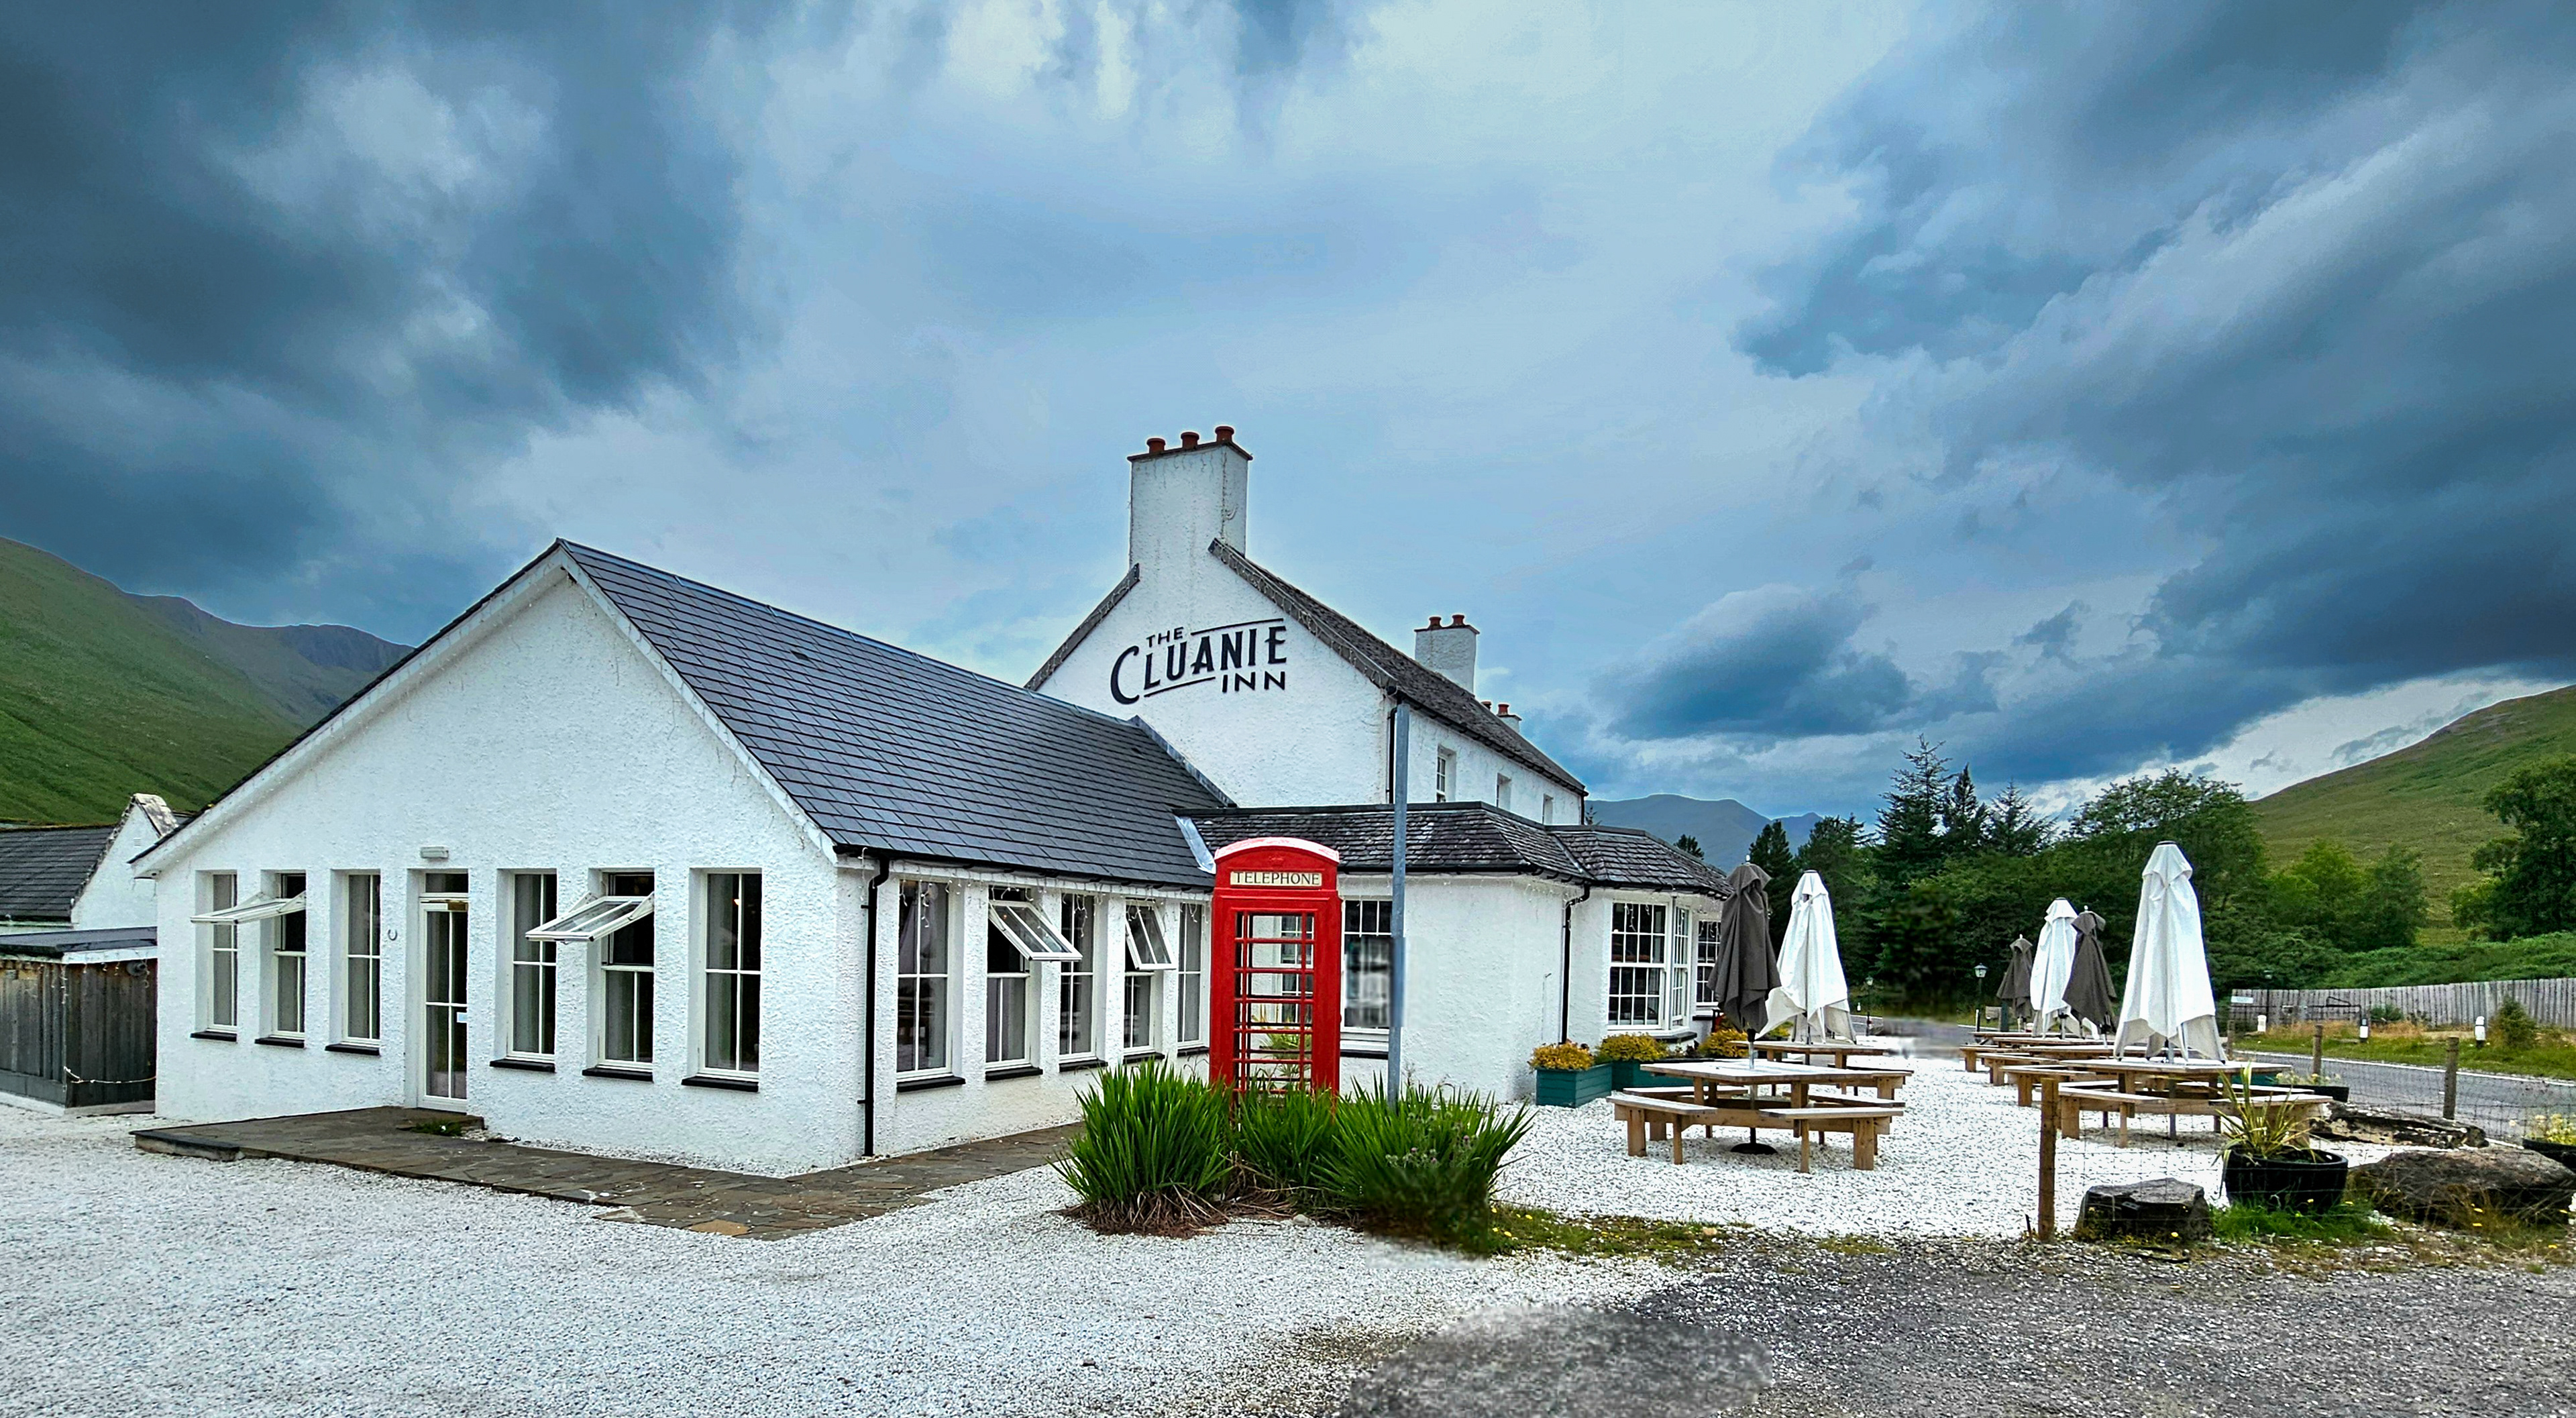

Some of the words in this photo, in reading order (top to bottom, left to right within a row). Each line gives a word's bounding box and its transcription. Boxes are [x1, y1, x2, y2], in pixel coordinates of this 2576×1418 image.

[1146, 626, 1184, 648] THE
[1110, 625, 1287, 705] CLUANIE
[1222, 671, 1285, 693] INN
[1234, 871, 1320, 885] TELEPHONE
